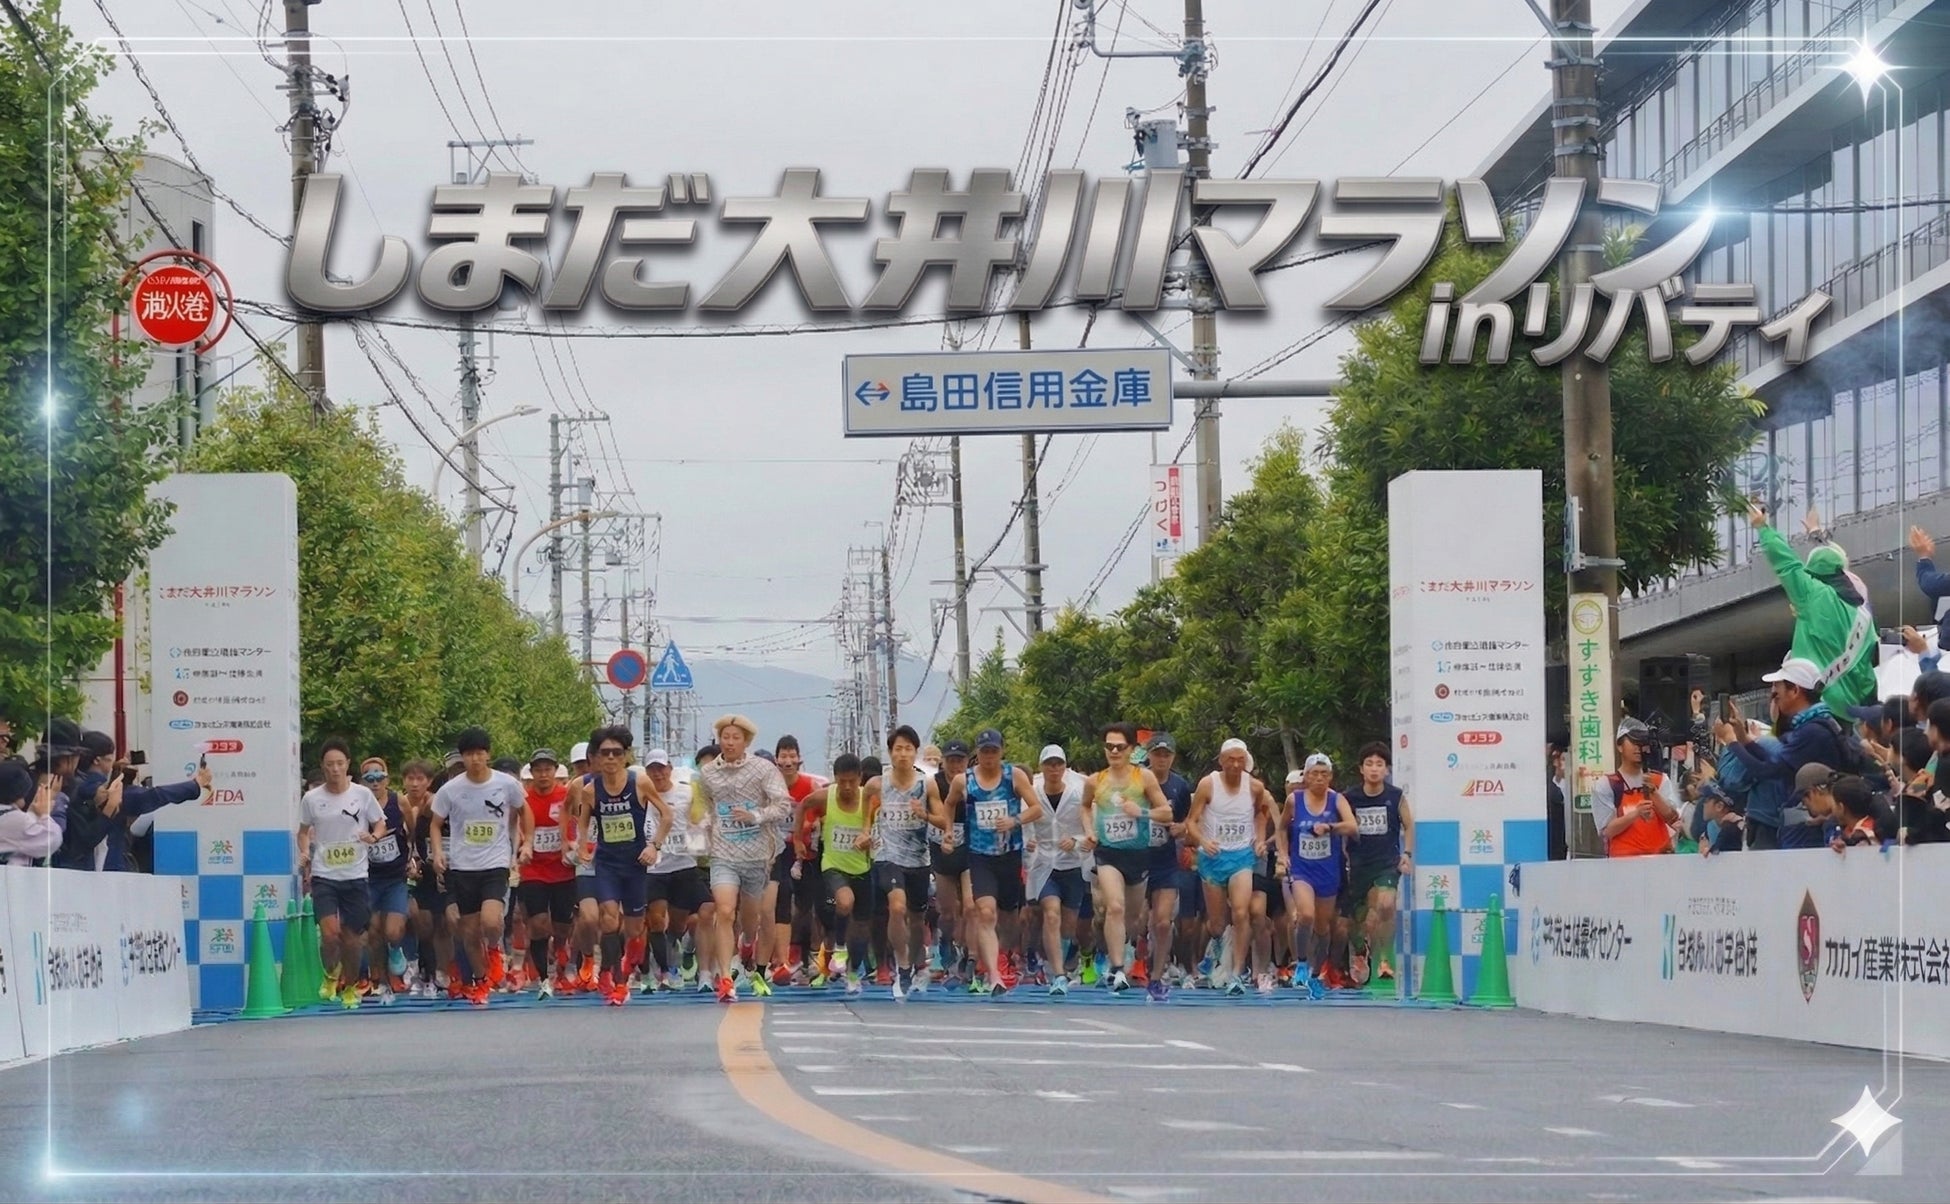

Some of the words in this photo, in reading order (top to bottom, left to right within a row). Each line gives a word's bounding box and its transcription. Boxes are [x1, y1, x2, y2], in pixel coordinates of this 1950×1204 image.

[900, 367, 1152, 412] 島田信用金庫
[1475, 780, 1505, 793] FDA
[215, 789, 245, 802] FDA
[1105, 820, 1134, 833] 2597
